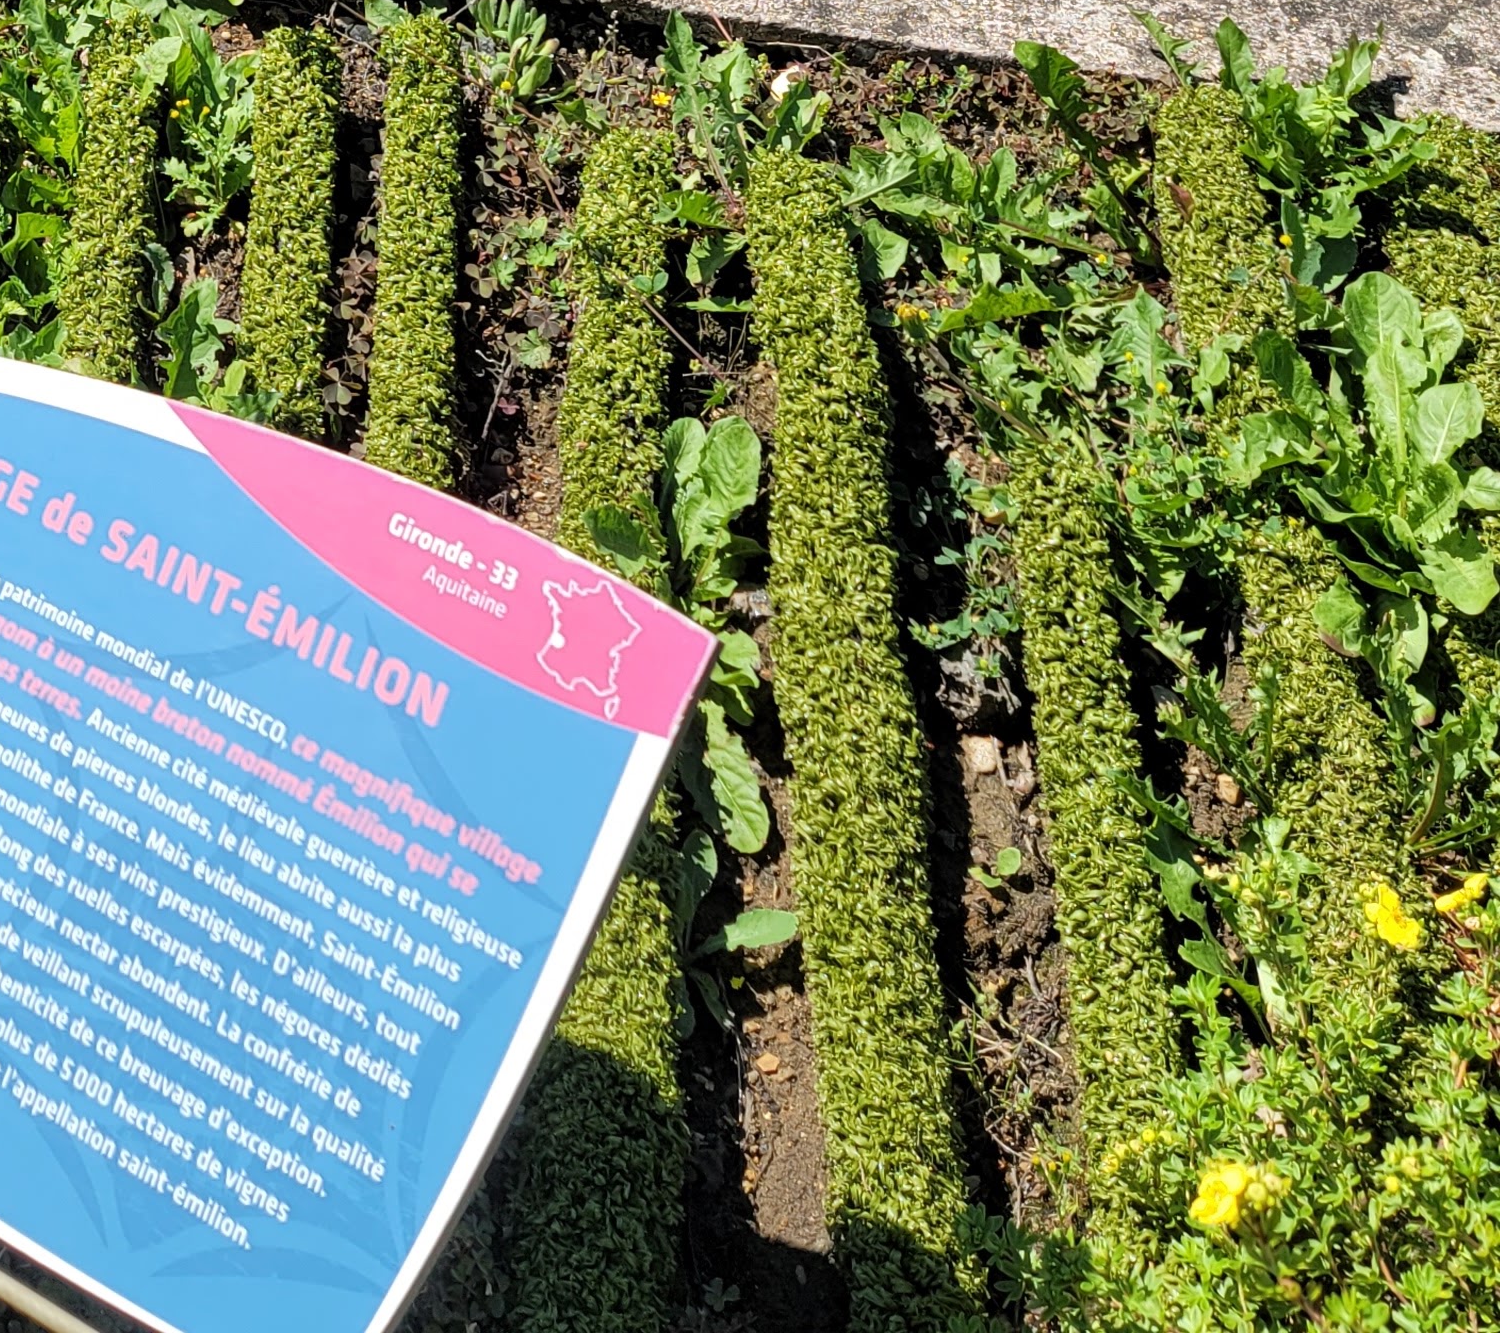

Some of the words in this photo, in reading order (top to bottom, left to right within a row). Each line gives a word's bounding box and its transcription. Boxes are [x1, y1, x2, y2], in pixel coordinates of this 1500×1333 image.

[41, 492, 94, 545] de
[99, 518, 449, 727] SAINT-ÉMILION
[388, 512, 474, 570] Gironde
[488, 559, 519, 591] 33
[421, 564, 508, 619] Aquitaine
[18, 668, 81, 720] terres.
[85, 707, 170, 768] Ancienne
[171, 757, 207, 789] cité
[208, 778, 305, 845] médiévale
[304, 834, 395, 896] guerrière
[397, 885, 421, 911] et
[421, 899, 522, 969] religieuse
[36, 636, 55, 660] à
[53, 648, 85, 677] un
[83, 665, 153, 714] moine
[151, 696, 226, 754] breton
[224, 742, 313, 802] nommé
[311, 785, 405, 854] Émilion
[404, 842, 451, 878] qui
[448, 865, 478, 895] se
[48, 730, 73, 757] de
[71, 746, 136, 793] pierres
[136, 776, 212, 841] blondes,
[217, 823, 237, 851] le
[238, 835, 275, 873] lieu
[276, 862, 335, 908] abrite
[336, 897, 392, 941] aussi
[392, 924, 413, 954] la
[413, 942, 460, 982] plus
[94, 630, 170, 680] mondial
[169, 668, 194, 694] de
[194, 678, 286, 749] l'UNESCO,
[290, 734, 319, 761] ce
[318, 749, 456, 837] magnifique
[457, 824, 542, 883] village
[32, 853, 66, 887] des
[66, 876, 129, 925] ruelles
[130, 914, 224, 989] escarpées,
[230, 969, 259, 1006] les
[261, 994, 342, 1056] négoces
[343, 1043, 411, 1099] dédiés
[52, 776, 77, 803] de
[77, 787, 140, 842] France.
[144, 827, 191, 870] Mais
[192, 857, 315, 948] évidemment,
[320, 930, 459, 1029] Saint-Émilion
[59, 917, 118, 964] nectar
[118, 954, 211, 1026] abondent.
[216, 1010, 241, 1043] La
[243, 1032, 332, 1099] confrérie
[333, 1087, 360, 1117] de
[70, 829, 84, 853] à
[85, 841, 117, 872] ses
[119, 860, 158, 897] vins
[157, 885, 266, 964] prestigieux.
[272, 948, 368, 1028] D'ailleurs,
[375, 1012, 421, 1055] tout
[1, 1065, 116, 1158] l'appellation
[117, 1148, 249, 1249] saint-émilion.
[22, 939, 90, 996] veillant
[90, 984, 254, 1099] scrupuleusement
[254, 1088, 289, 1120] sur
[289, 1104, 310, 1135] la
[311, 1125, 384, 1181] qualité
[33, 1042, 58, 1071] de
[112, 1090, 194, 1160] hectares
[195, 1148, 222, 1178] de
[225, 1167, 289, 1222] vignes
[69, 1017, 94, 1046] de
[95, 1036, 118, 1061] ce
[118, 1044, 206, 1118] breuvage
[207, 1106, 325, 1197] d'exception.
